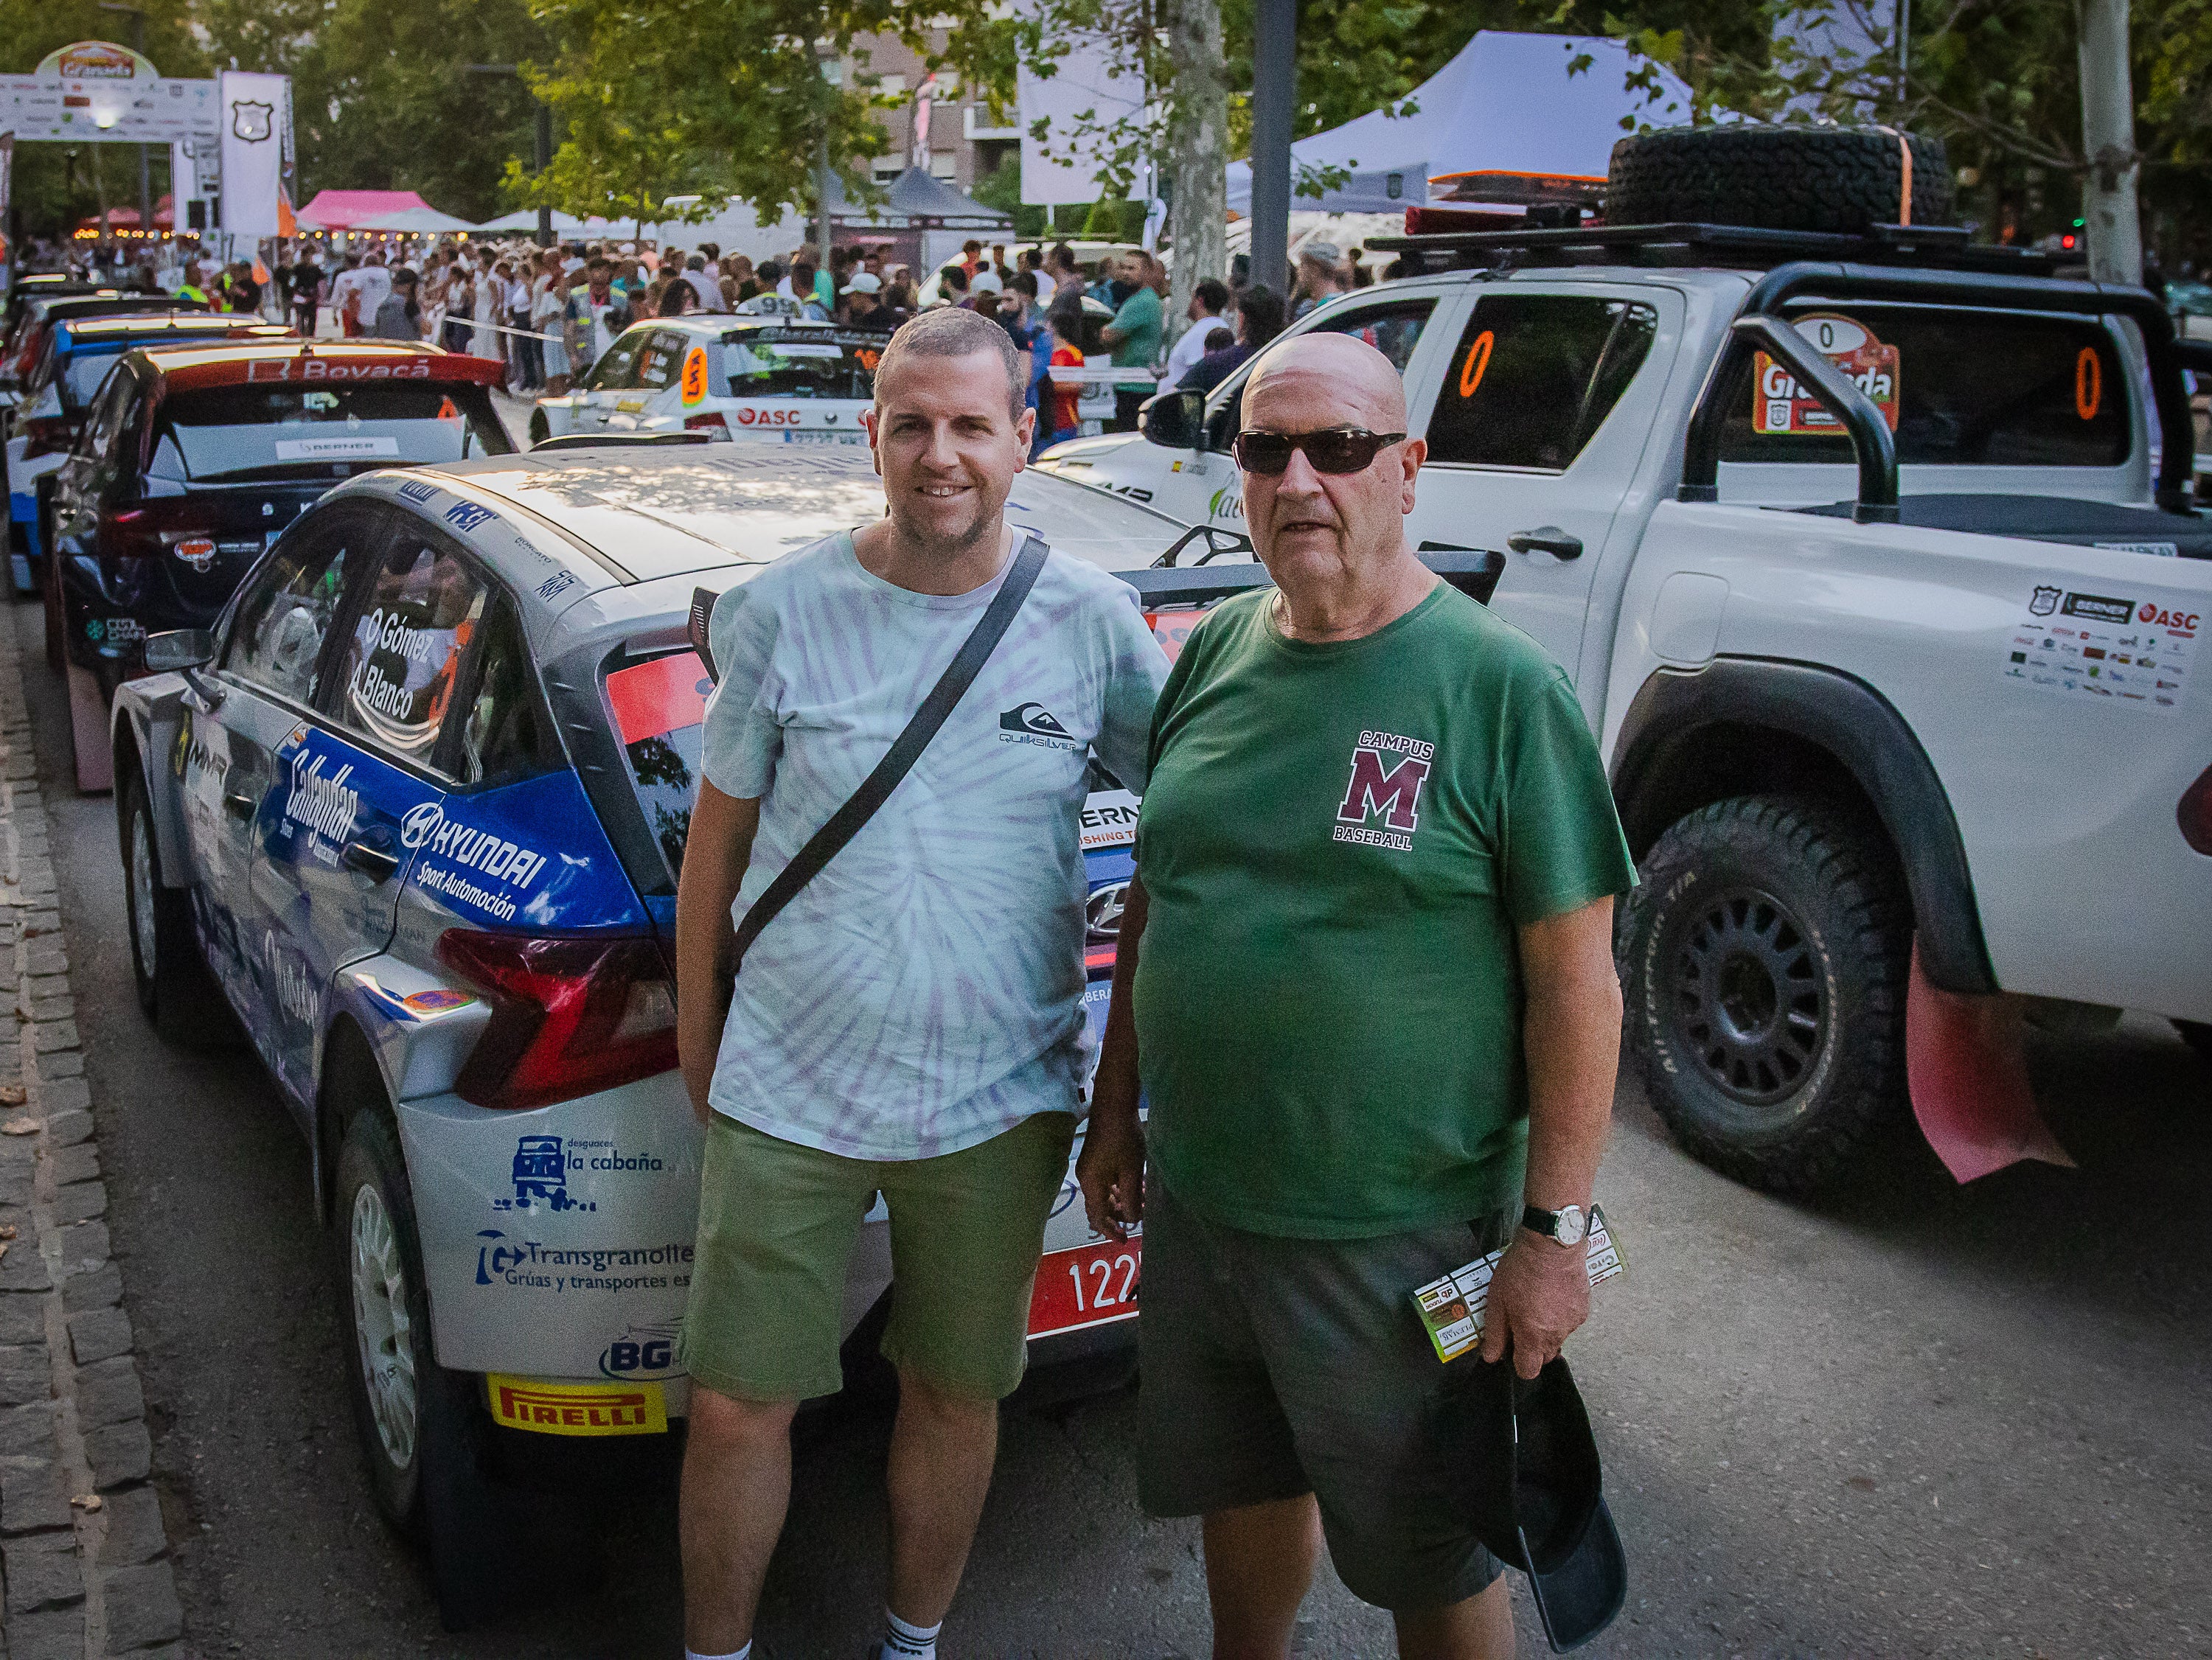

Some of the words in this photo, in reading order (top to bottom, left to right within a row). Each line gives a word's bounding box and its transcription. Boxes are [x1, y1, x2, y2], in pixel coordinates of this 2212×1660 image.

[1819, 322, 1834, 348] 0
[1460, 330, 1495, 397] 0
[2076, 346, 2101, 420] 0
[758, 410, 801, 426] ASC
[2154, 609, 2200, 631] ASC
[1358, 730, 1435, 760] CAMPUS
[1336, 747, 1432, 832] M
[1332, 825, 1413, 852] BASEBALL
[431, 819, 548, 890] HYUNDAI
[417, 860, 448, 887] Sport
[442, 872, 517, 921] Automoción
[568, 1137, 614, 1150] desguaces
[566, 1150, 584, 1171] la
[590, 1150, 663, 1171] cabaña
[504, 1269, 552, 1288] Grúas
[557, 1277, 566, 1293] y
[570, 1276, 667, 1293] transportes
[609, 1340, 672, 1372] BG
[499, 1386, 647, 1426] PIRELLI
